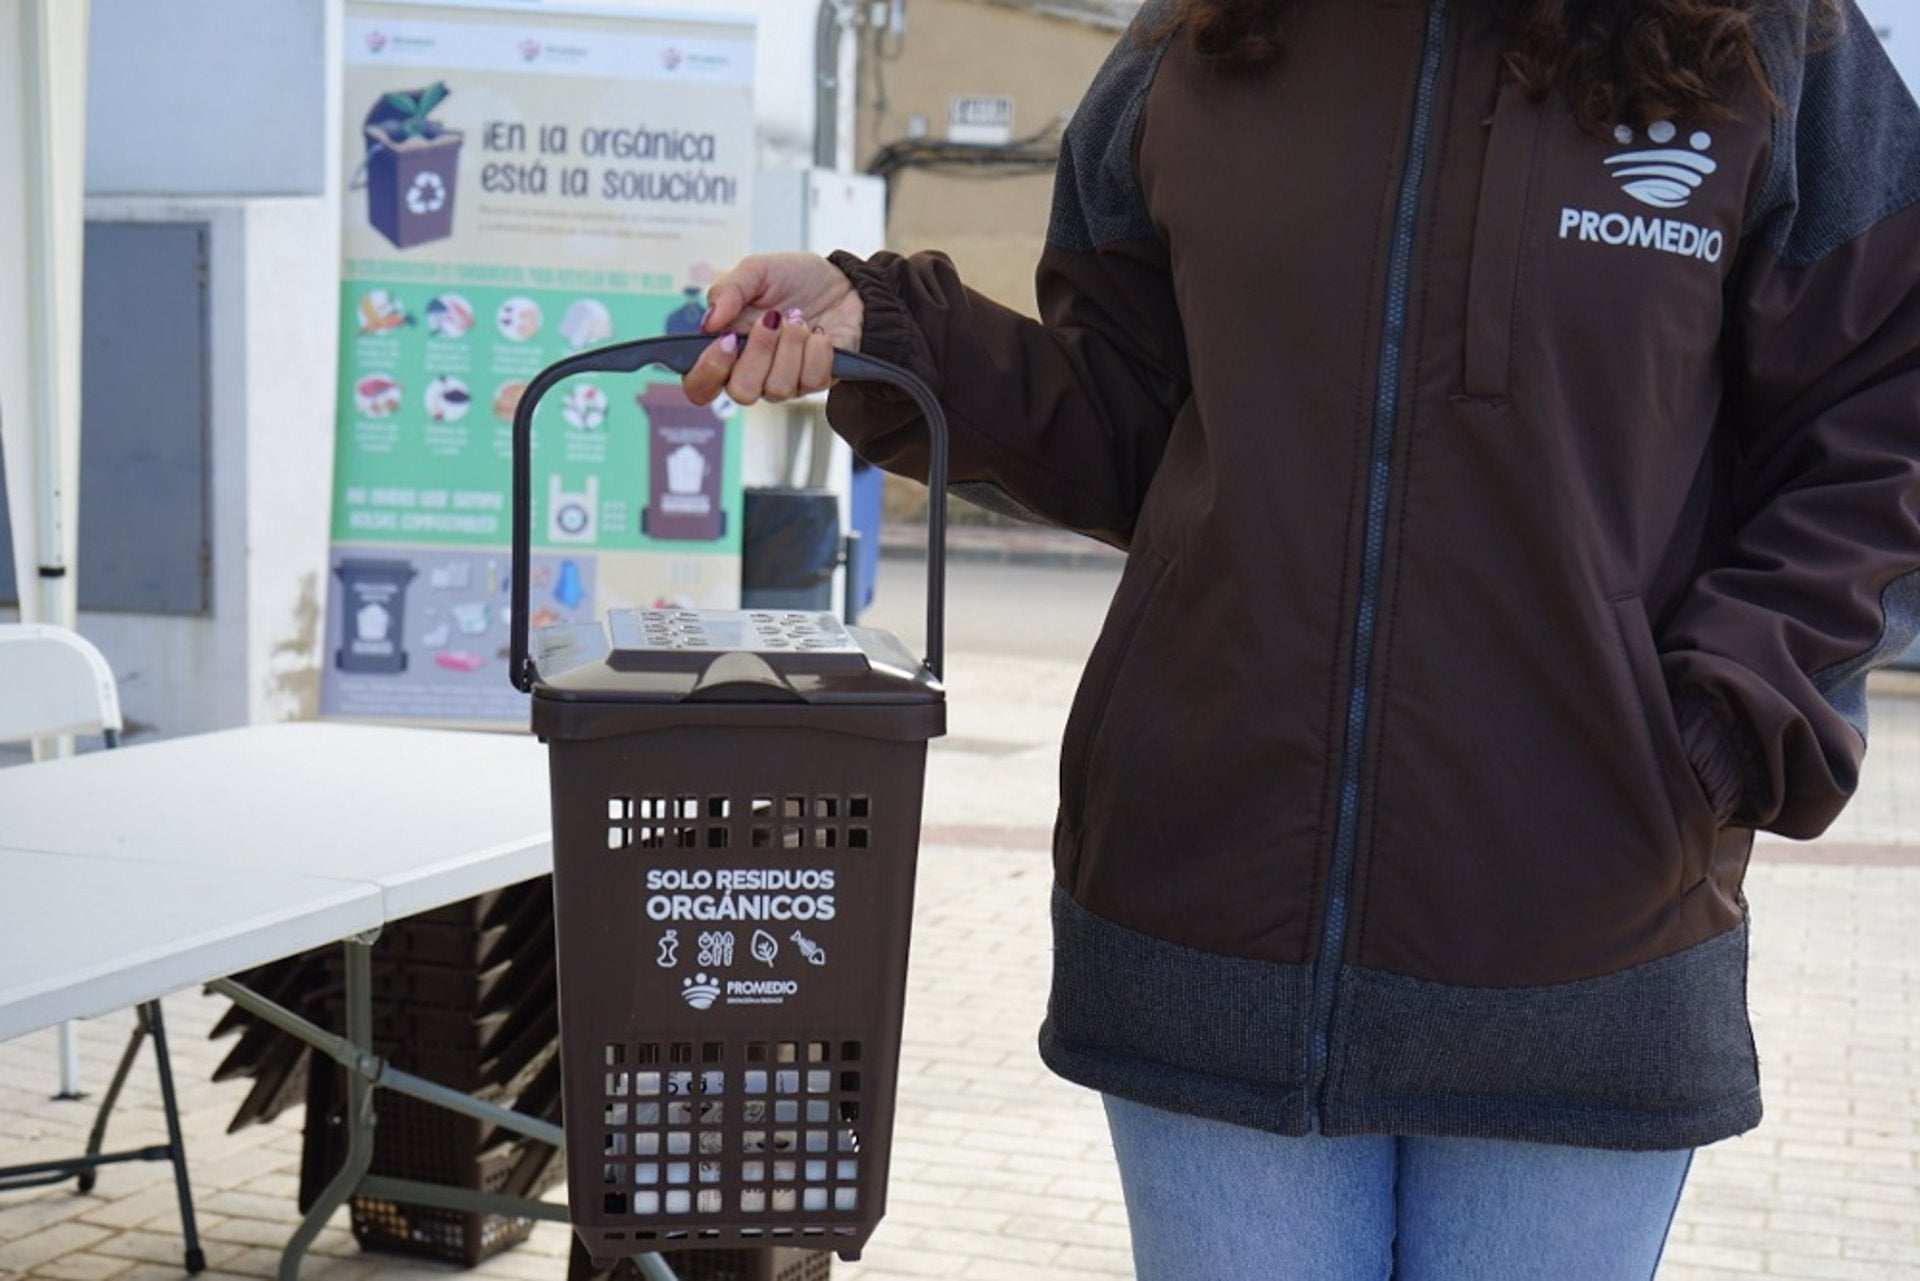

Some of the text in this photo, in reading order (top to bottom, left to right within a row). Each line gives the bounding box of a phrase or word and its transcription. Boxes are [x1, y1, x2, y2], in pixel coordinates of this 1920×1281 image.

[540, 125, 567, 154] la
[481, 160, 737, 206] está la solución!
[1559, 208, 1723, 262] PROMEDIO
[646, 869, 835, 889] SOLO RESIDUOS
[646, 889, 836, 920] ORGÁNICOS
[727, 981, 797, 995] PROMEDIO
